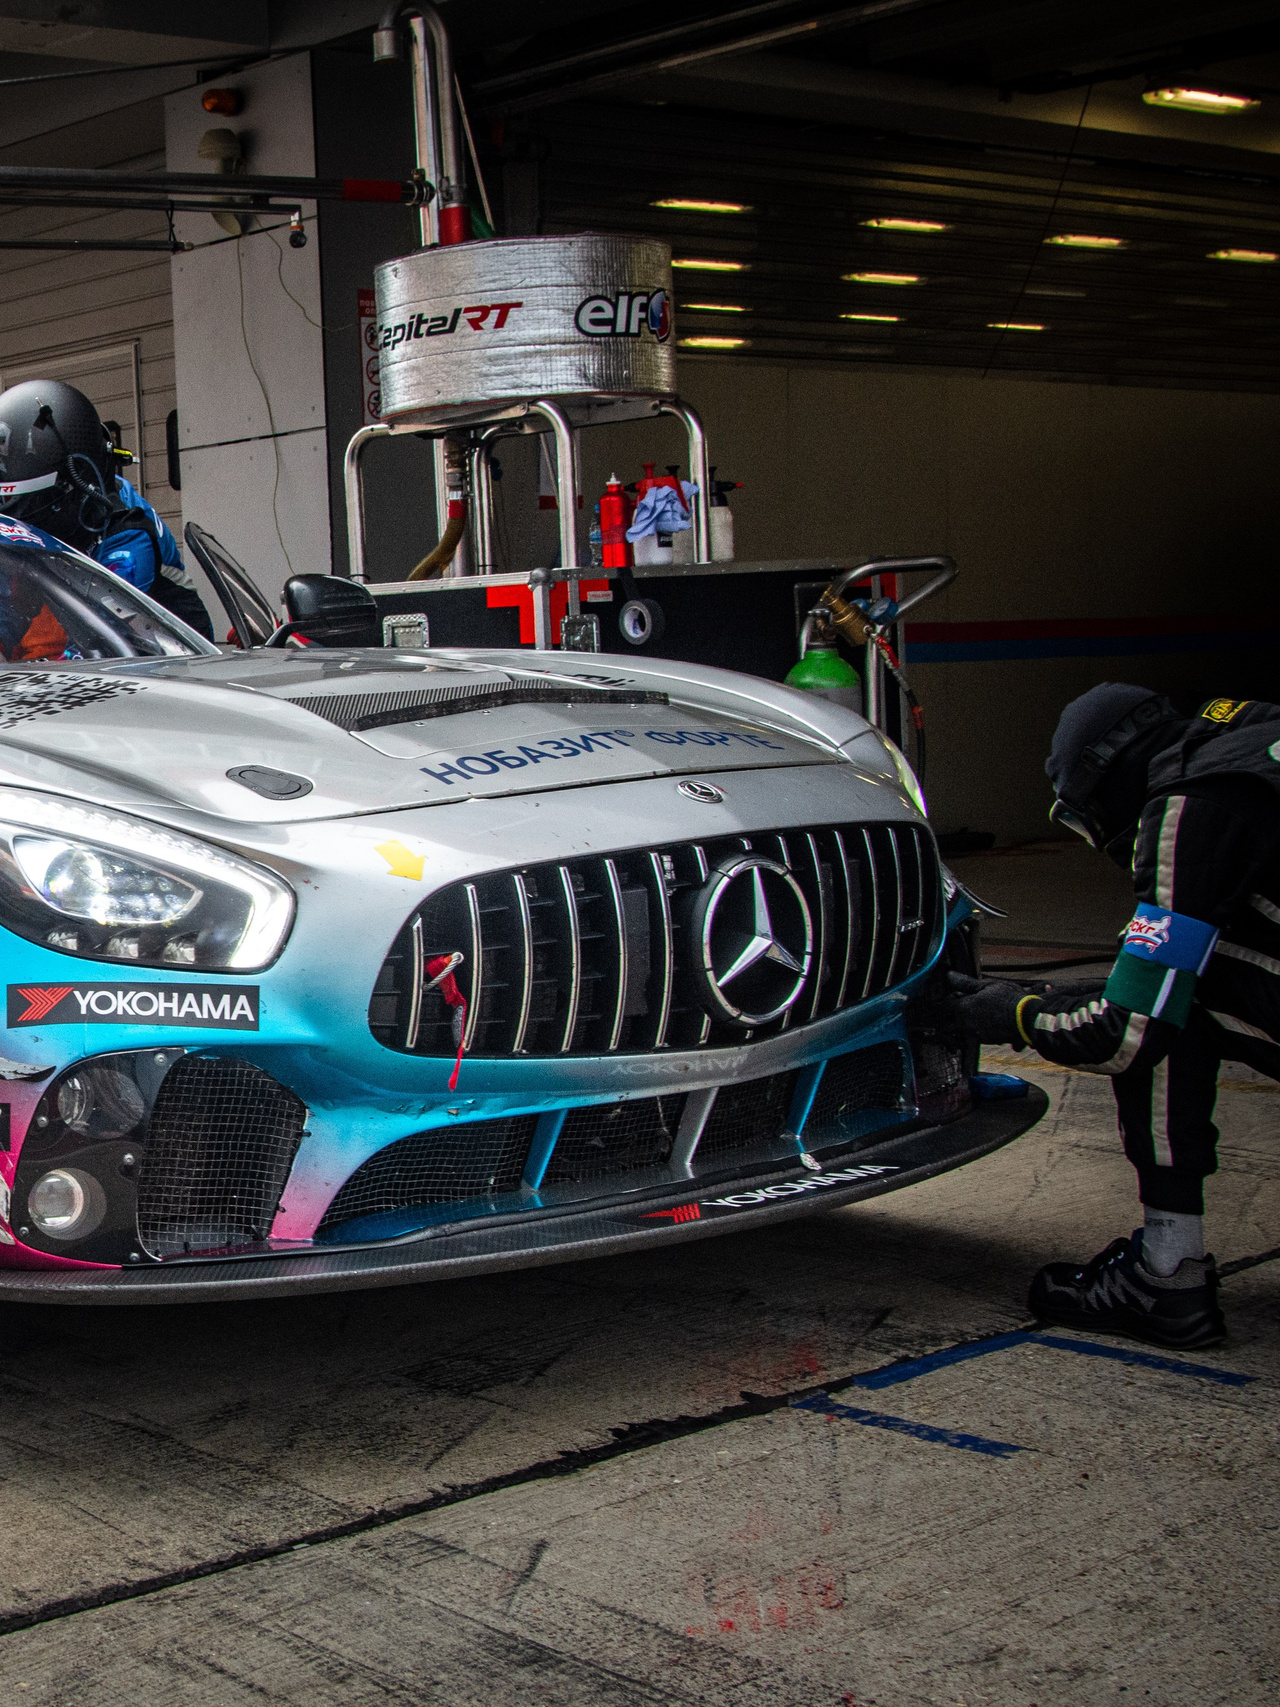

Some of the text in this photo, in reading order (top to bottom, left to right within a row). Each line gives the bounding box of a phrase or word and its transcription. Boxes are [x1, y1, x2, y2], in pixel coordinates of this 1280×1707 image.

[577, 296, 648, 336] elf
[645, 731, 786, 751] ФОРТЕ
[73, 990, 255, 1022] YOKOHAMA
[701, 1163, 900, 1208] YOKOHAMA
